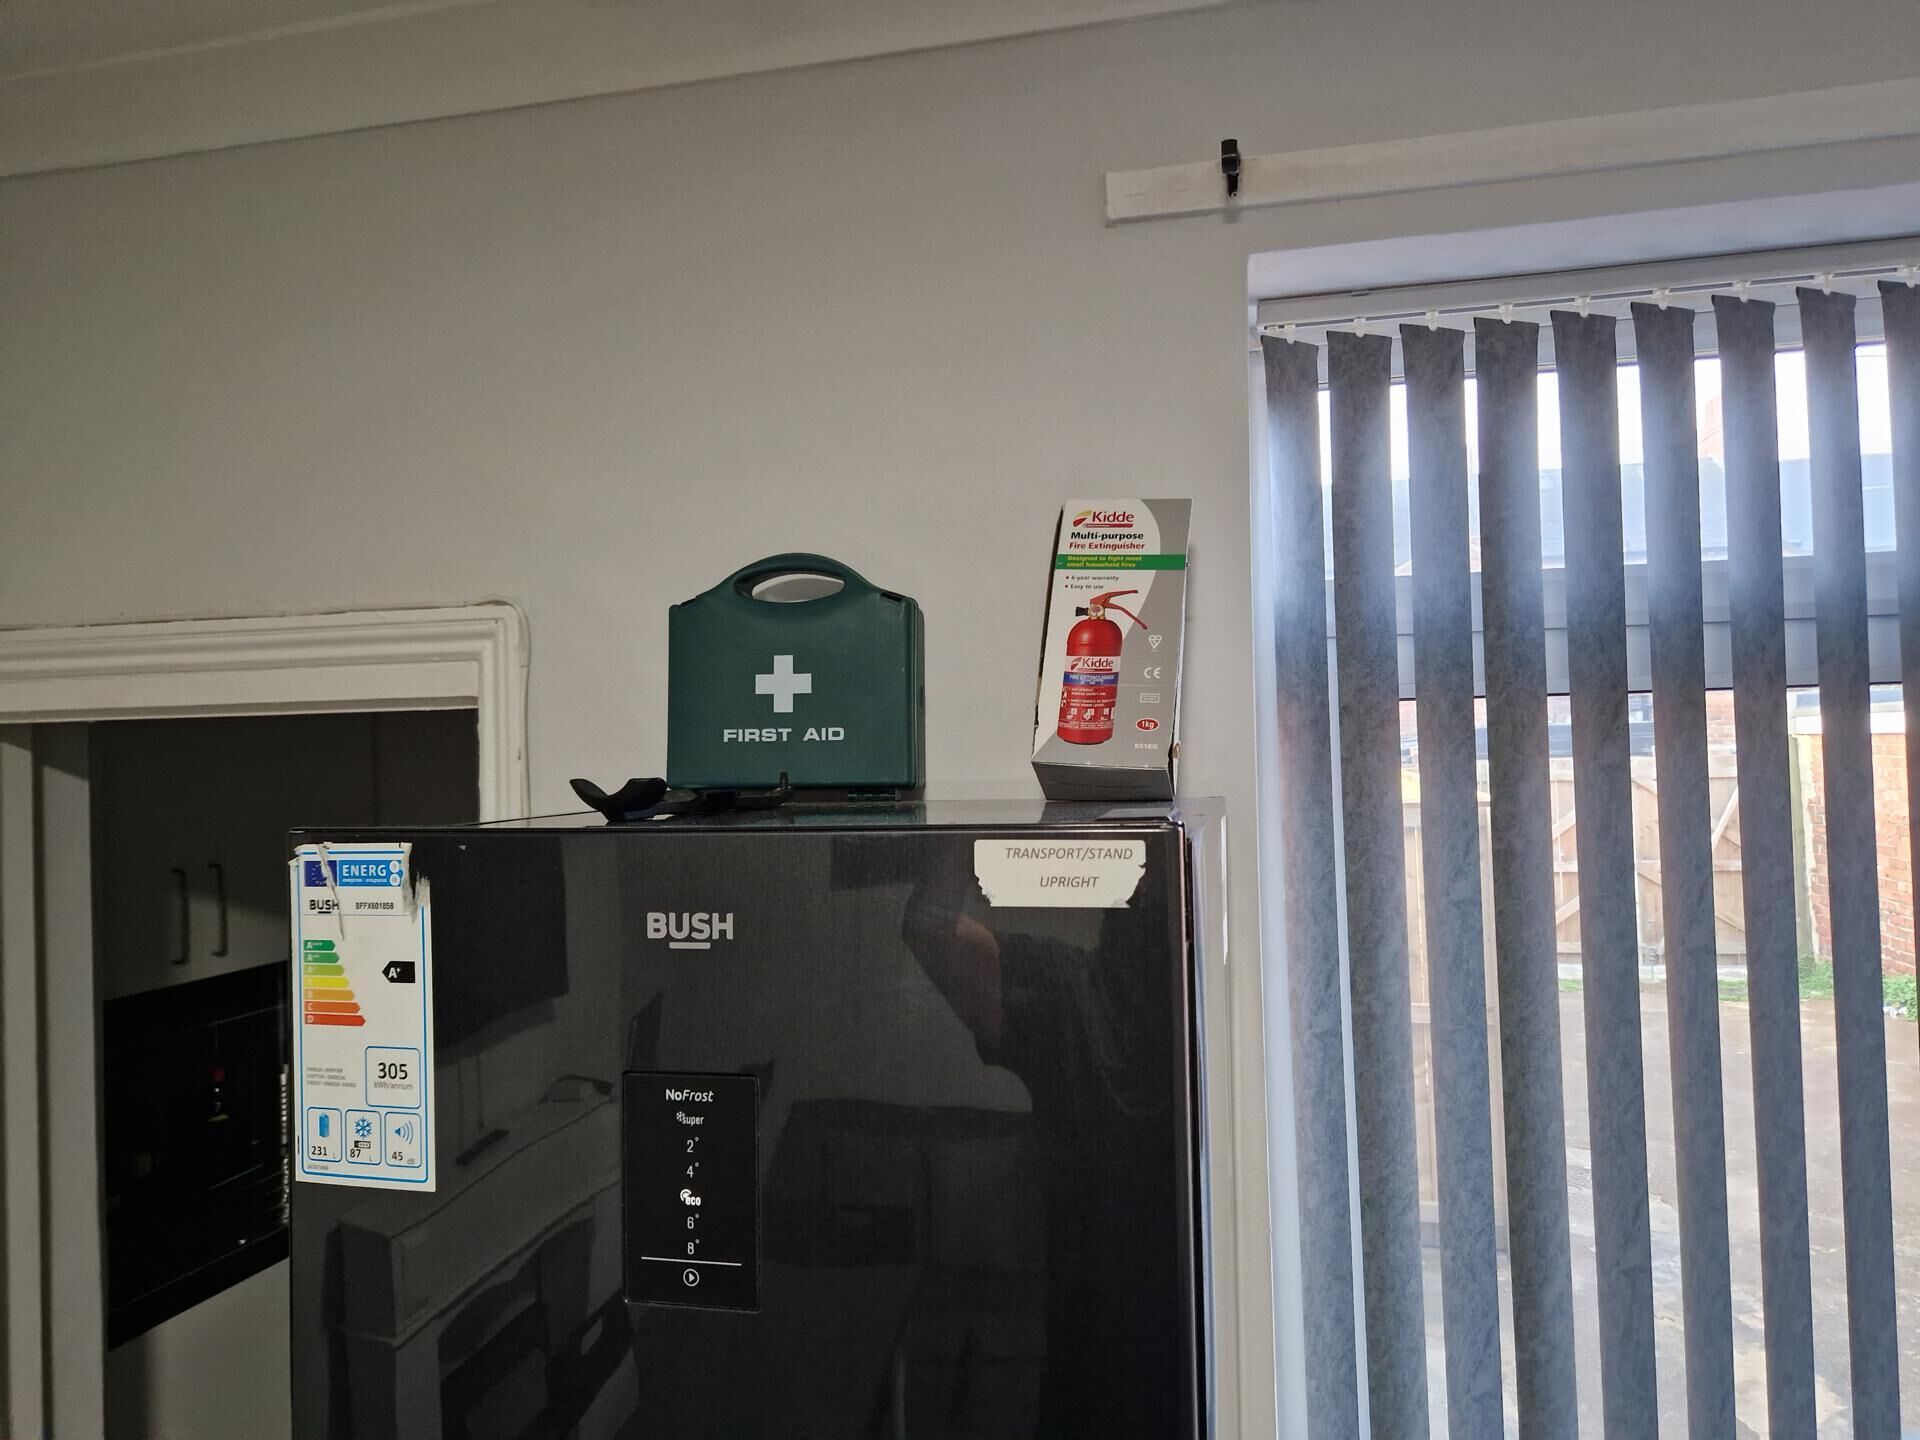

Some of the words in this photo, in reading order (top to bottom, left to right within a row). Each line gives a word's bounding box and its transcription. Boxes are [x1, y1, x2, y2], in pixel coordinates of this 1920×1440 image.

[1092, 511, 1134, 522] Kidde
[1070, 532, 1144, 541] Multi-purpose
[1088, 541, 1145, 551] Extinguisher
[1082, 657, 1114, 668] Kidde
[723, 728, 792, 743] FIRST
[803, 727, 845, 741] AID
[1006, 847, 1133, 861] TRANSPORT/STAND
[342, 865, 387, 876] ENERG
[1040, 876, 1099, 888] UPRIGHT
[309, 900, 339, 910] BUSH
[647, 912, 733, 940] BUSH
[388, 968, 402, 978] A+
[378, 1062, 408, 1080] 305
[374, 1082, 413, 1091] kWh/annum
[665, 1088, 714, 1102] NoFrost
[682, 1115, 704, 1126] super
[311, 1145, 328, 1156] 231
[350, 1148, 361, 1158] 87
[392, 1152, 403, 1161] 45
[685, 1196, 701, 1206] eco
